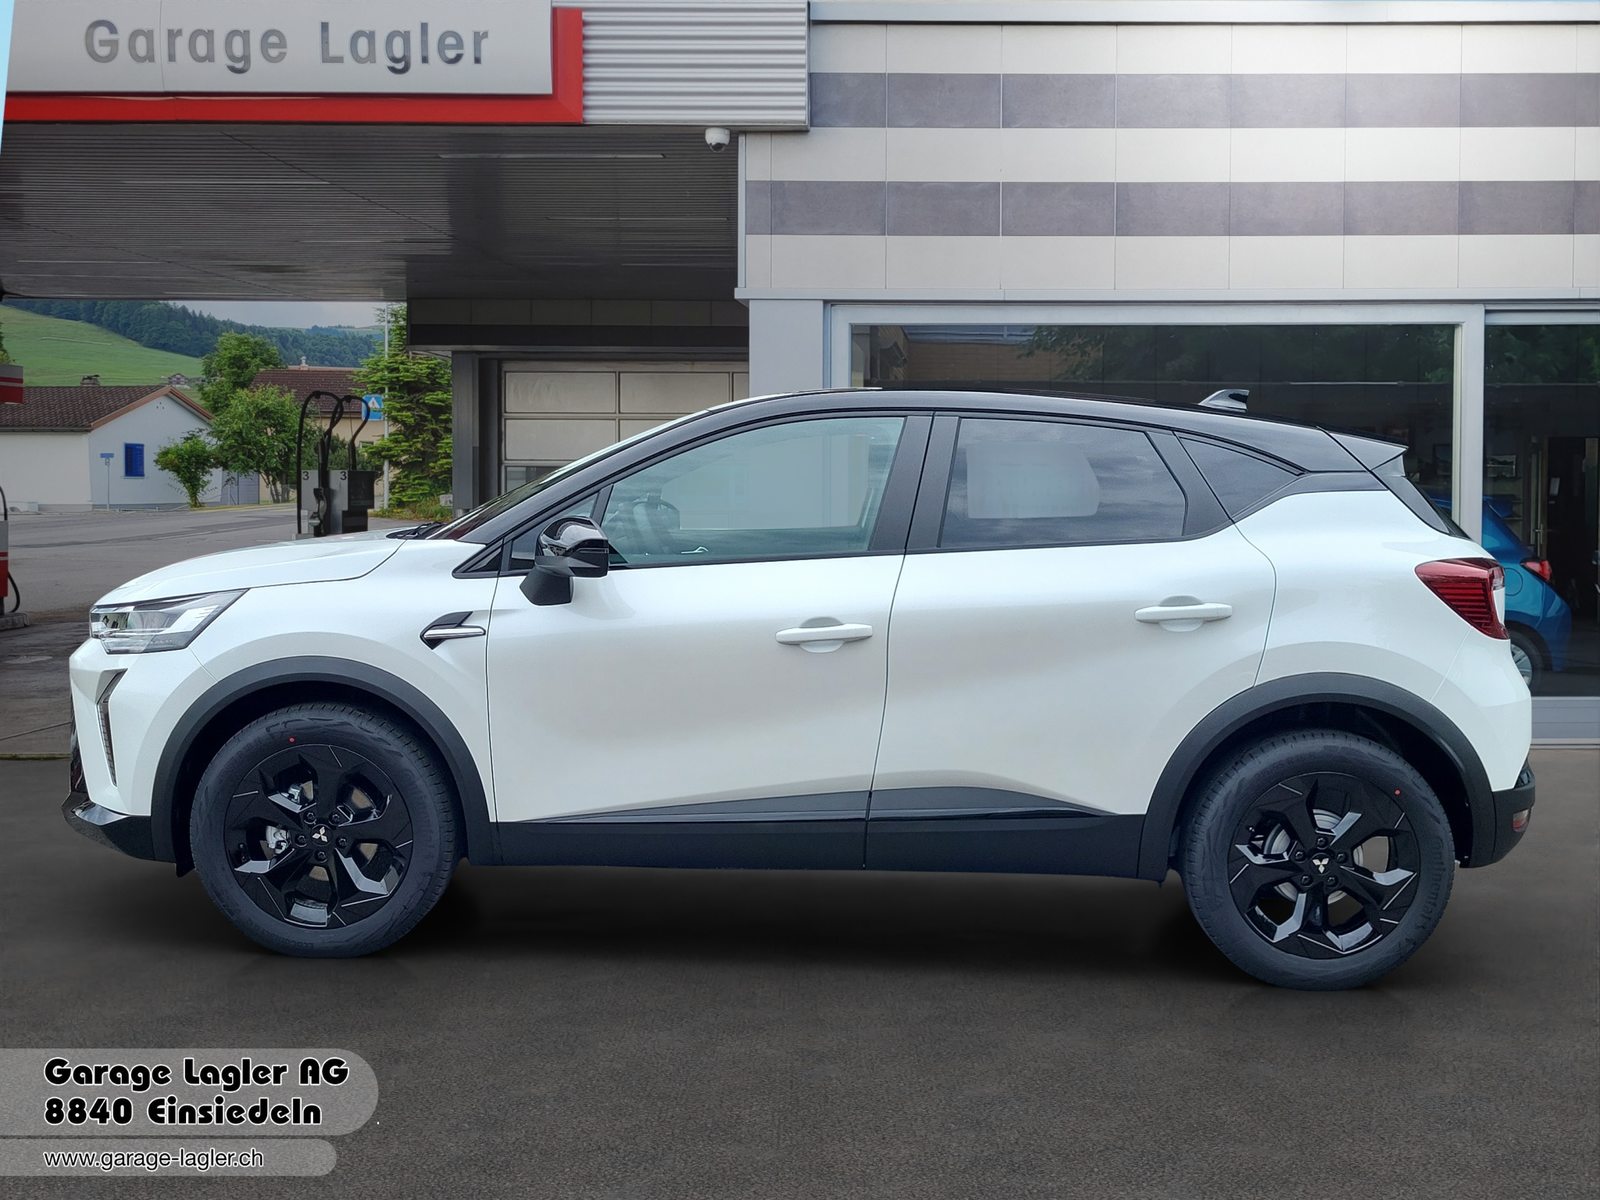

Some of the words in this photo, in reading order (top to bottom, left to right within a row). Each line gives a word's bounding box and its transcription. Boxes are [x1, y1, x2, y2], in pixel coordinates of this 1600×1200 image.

[84, 19, 288, 75] Garage
[319, 21, 490, 75] Lagler
[302, 471, 309, 481] 3
[340, 471, 348, 481] 3
